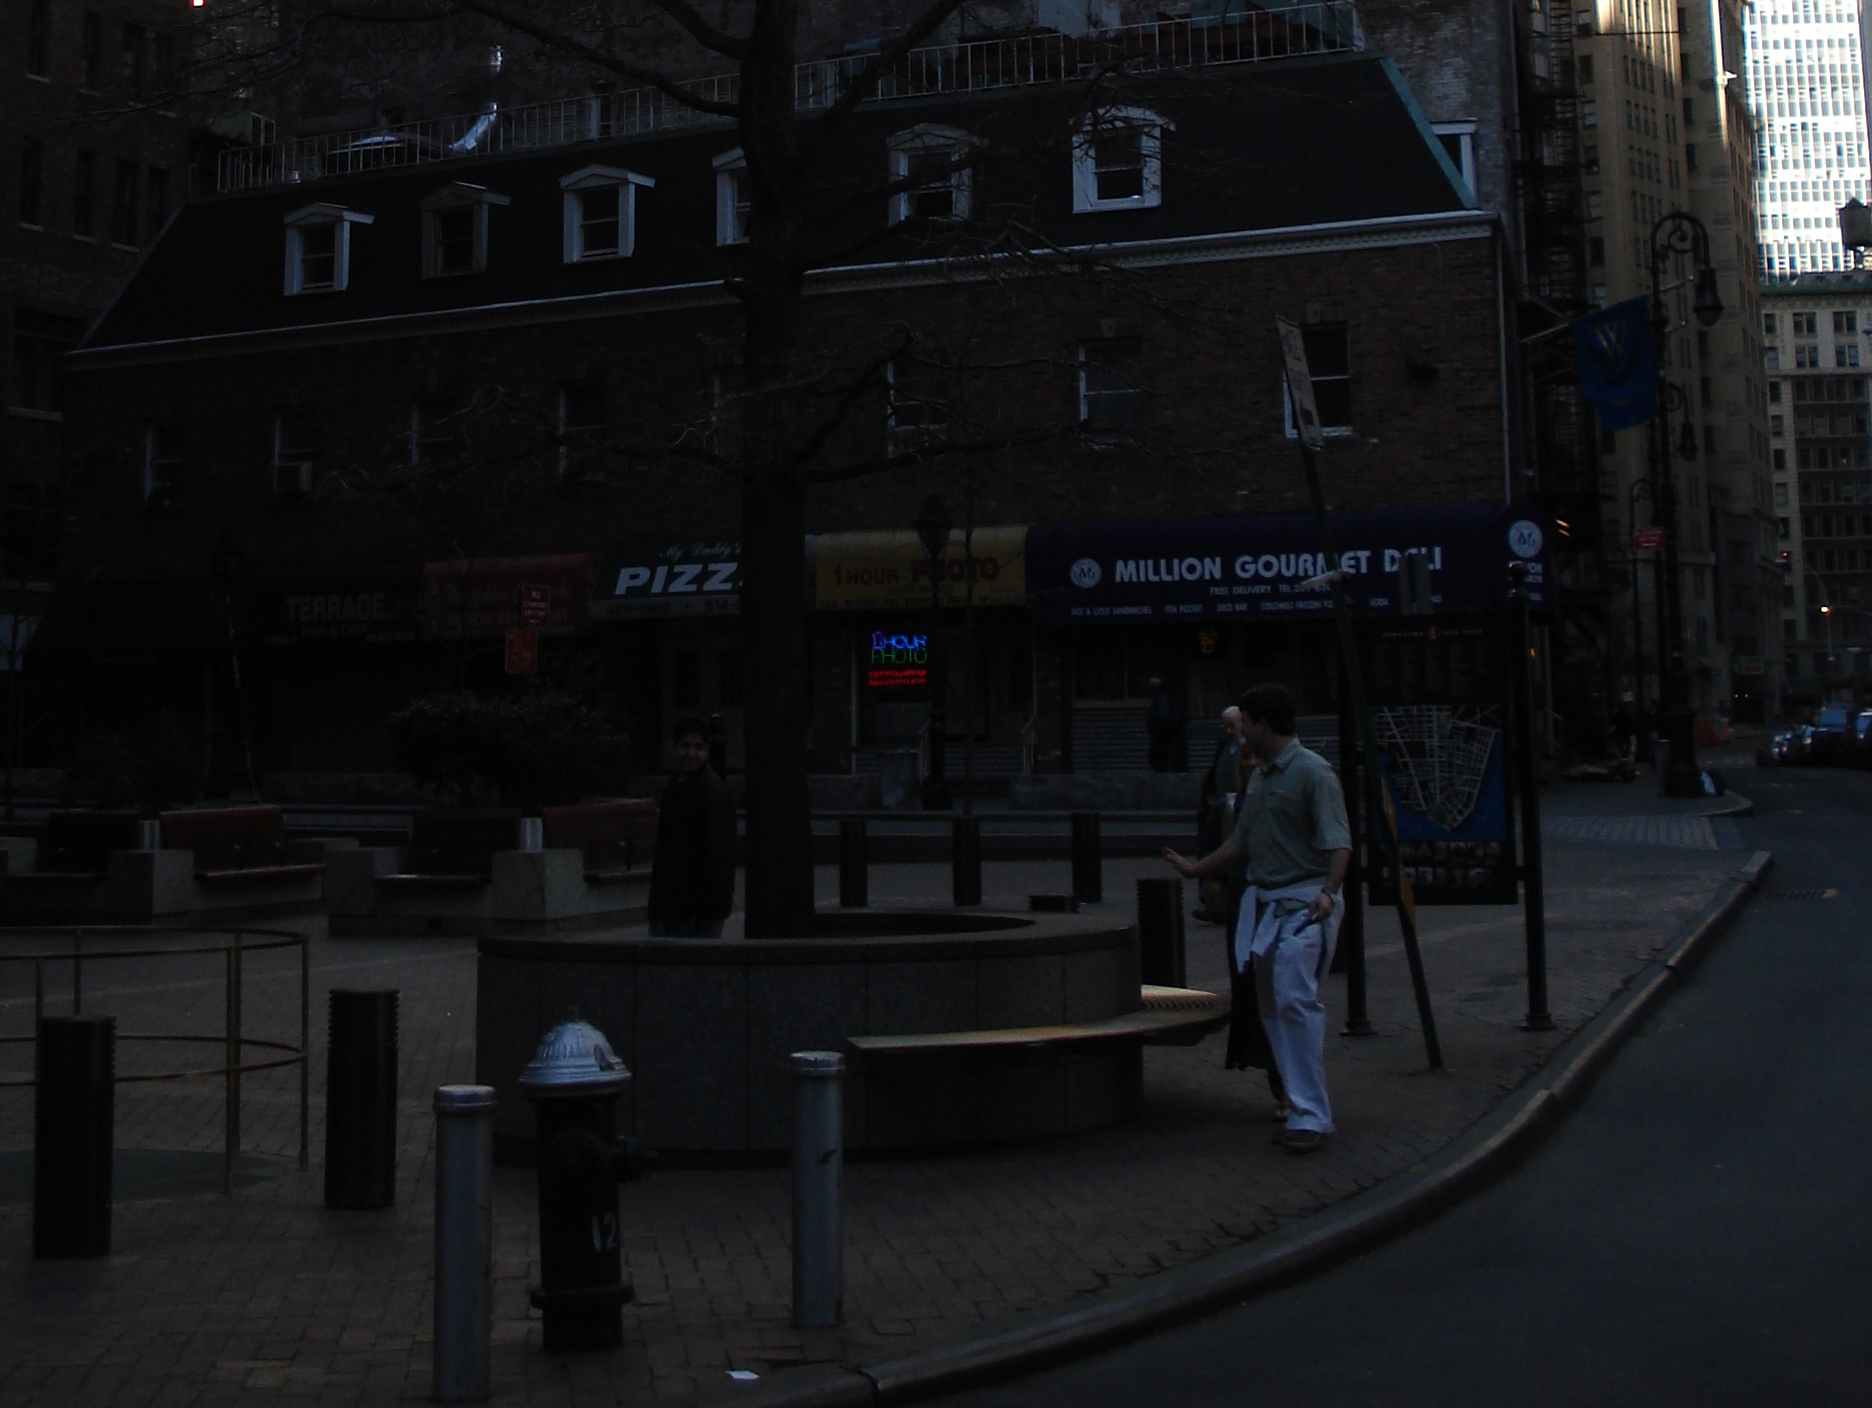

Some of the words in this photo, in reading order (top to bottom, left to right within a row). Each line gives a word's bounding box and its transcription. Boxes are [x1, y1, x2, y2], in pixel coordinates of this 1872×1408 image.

[614, 562, 743, 595] PIZZ
[847, 568, 899, 585] HOUR
[911, 556, 1000, 583] PHOTO
[1114, 556, 1222, 583] MILLION
[1384, 546, 1442, 573] DI
[1210, 586, 1230, 596] FREE
[1233, 585, 1272, 595] DELIVERY
[285, 592, 385, 623] TERRACE
[871, 647, 928, 664] PHOTO
